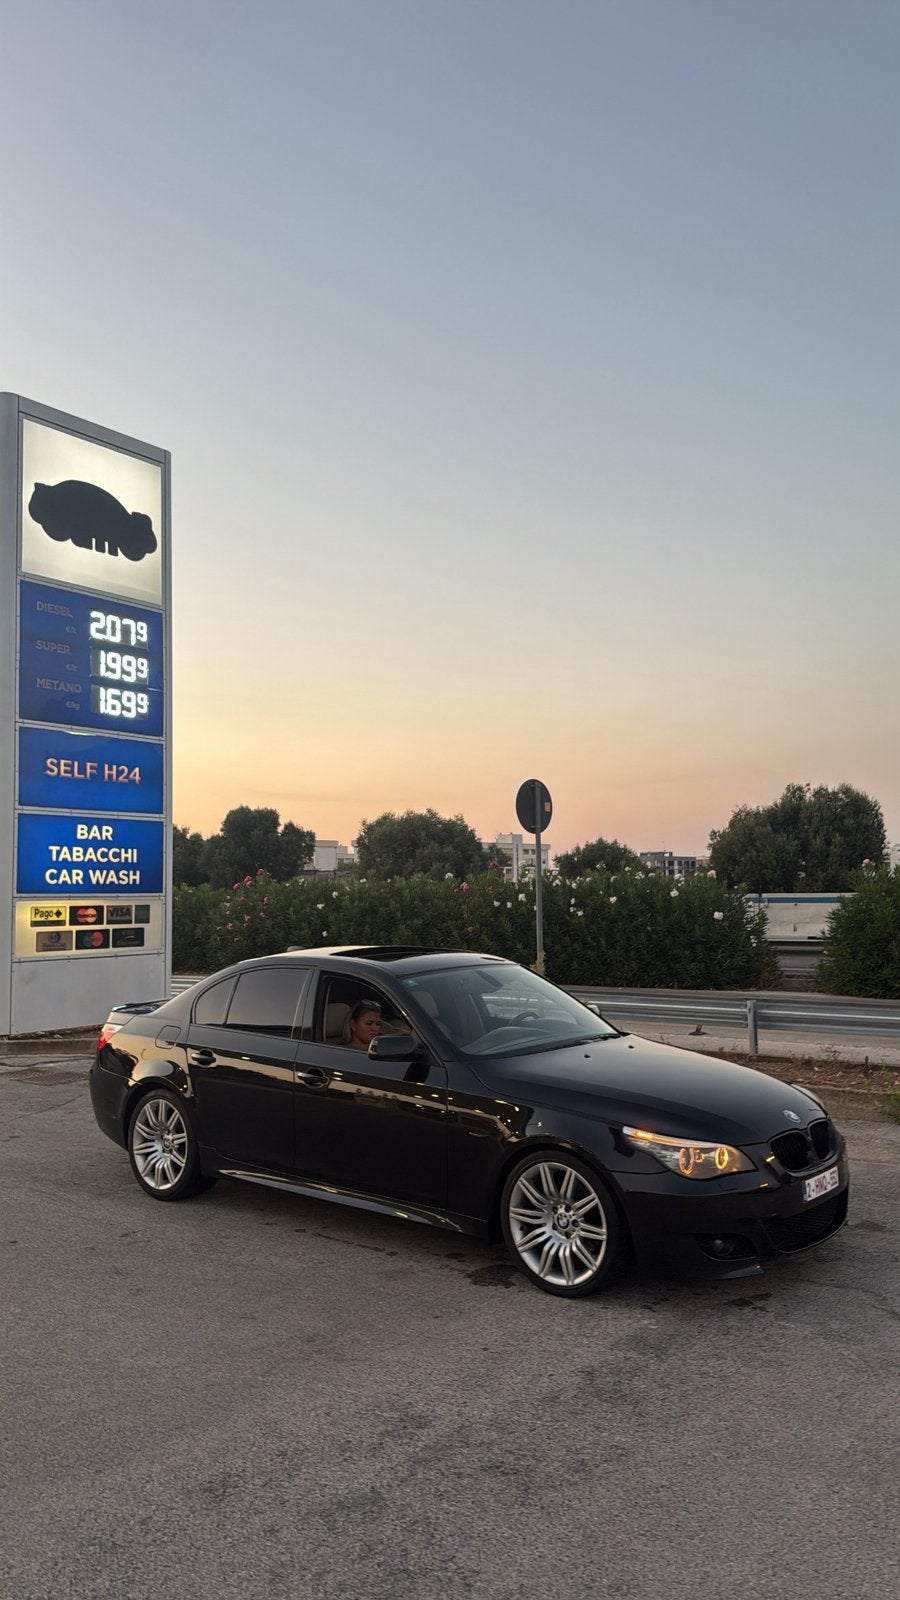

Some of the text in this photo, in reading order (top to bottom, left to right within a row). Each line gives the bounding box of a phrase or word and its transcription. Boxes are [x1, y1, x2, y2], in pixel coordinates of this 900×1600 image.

[36, 601, 73, 618] DIESEL
[35, 640, 72, 656] SUPER
[36, 678, 82, 693] METANO
[45, 757, 142, 784] SELF H24
[76, 824, 114, 841] BAR
[48, 845, 138, 864] TABACCHI
[45, 868, 141, 885] CAR WASH
[34, 908, 54, 920] Pago
[108, 907, 131, 918] VISA
